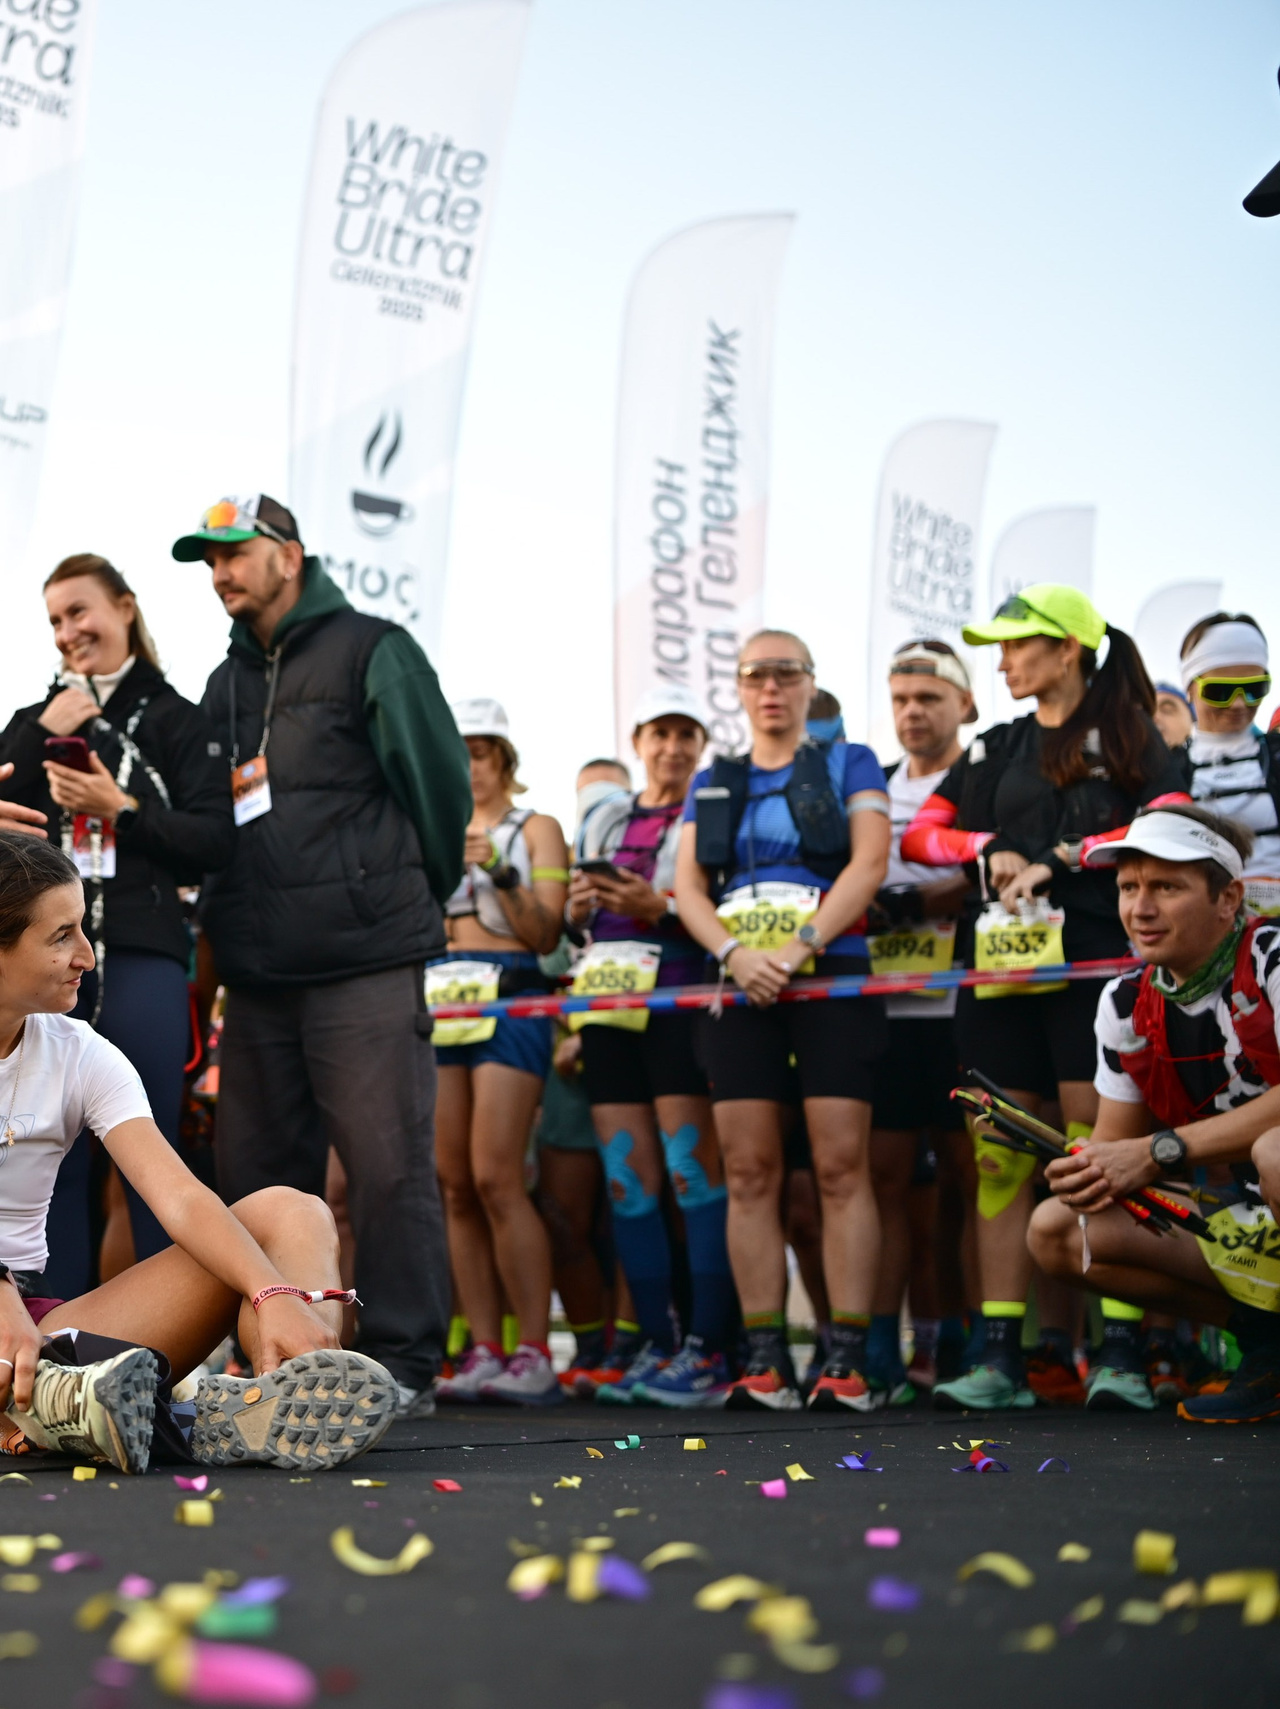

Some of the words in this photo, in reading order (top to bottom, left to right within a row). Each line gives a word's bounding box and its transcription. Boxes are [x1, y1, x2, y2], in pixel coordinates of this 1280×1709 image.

[345, 114, 488, 189] White
[336, 160, 482, 235] Bride
[334, 207, 475, 281] Ultra
[695, 317, 741, 611] Геленджик
[733, 910, 798, 935] 3895
